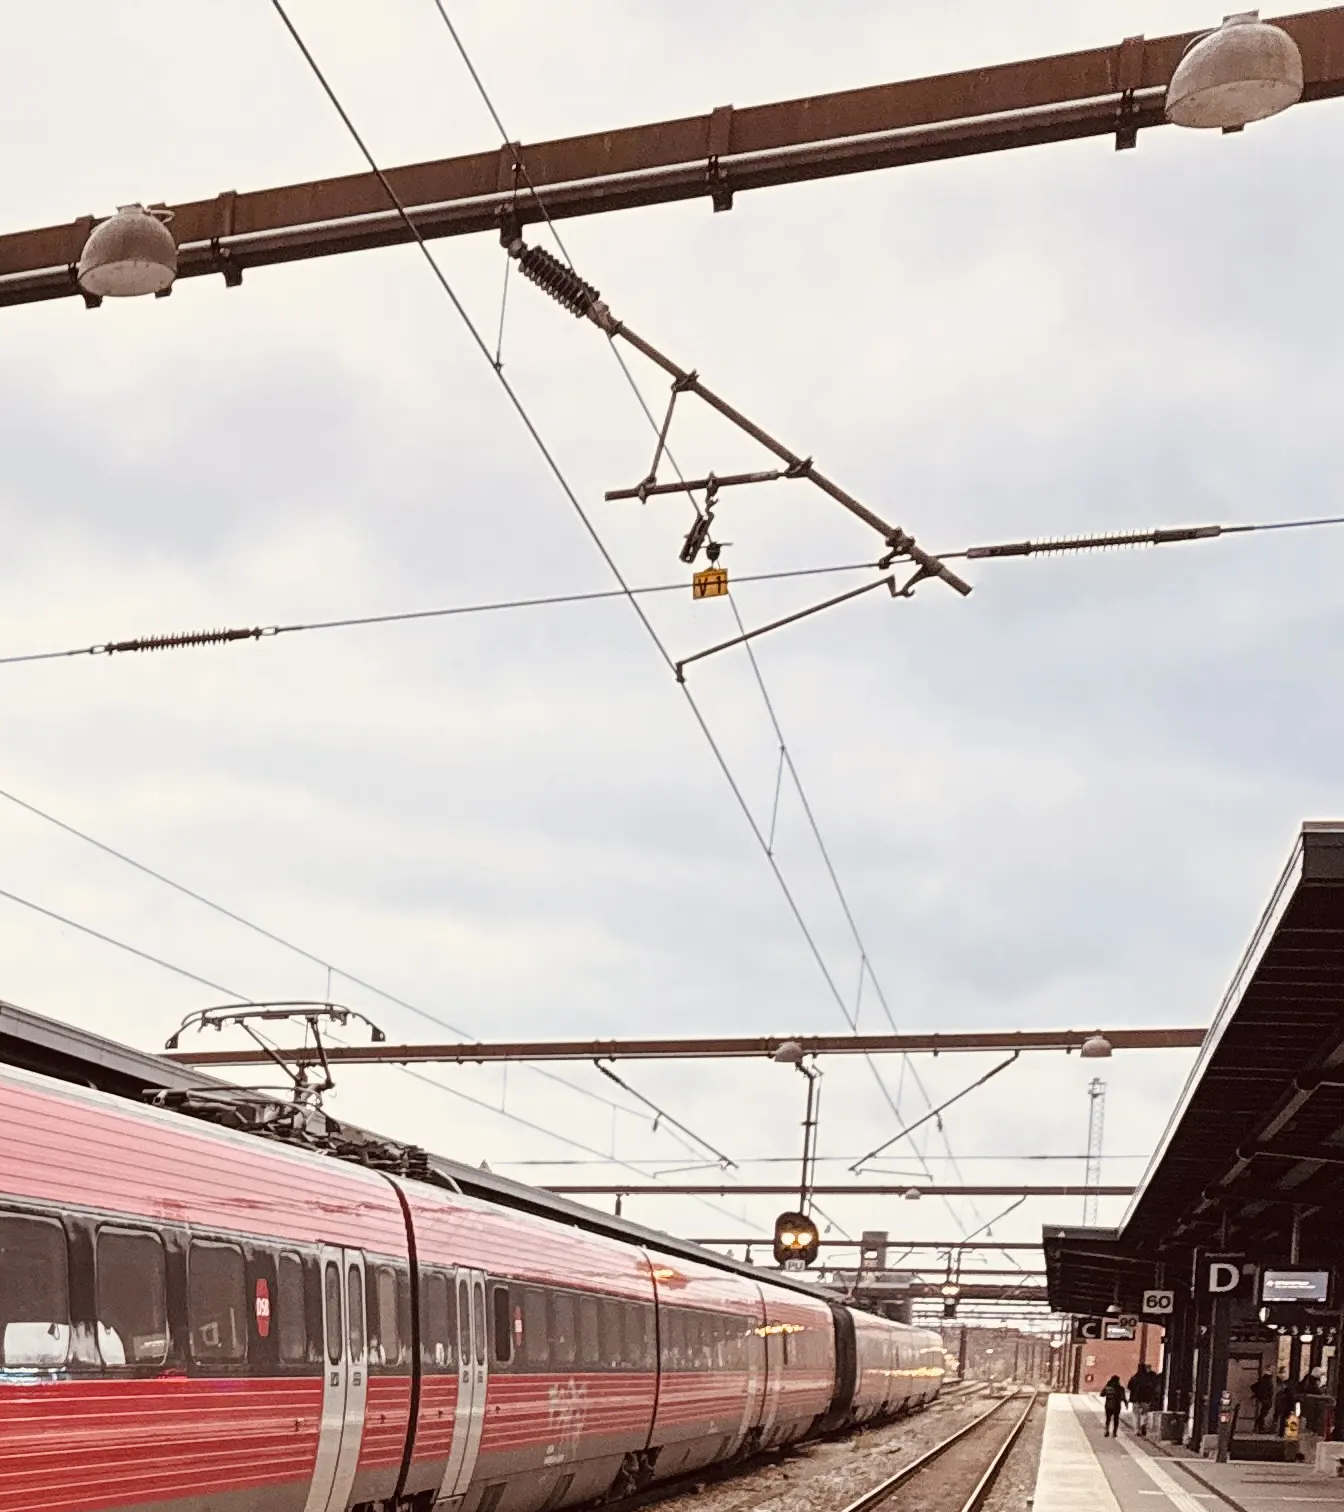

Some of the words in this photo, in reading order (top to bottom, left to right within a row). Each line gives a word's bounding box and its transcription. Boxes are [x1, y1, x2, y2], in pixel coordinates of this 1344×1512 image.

[1208, 1263, 1240, 1293] D
[1145, 1295, 1171, 1309] 60
[1081, 1322, 1097, 1338] C
